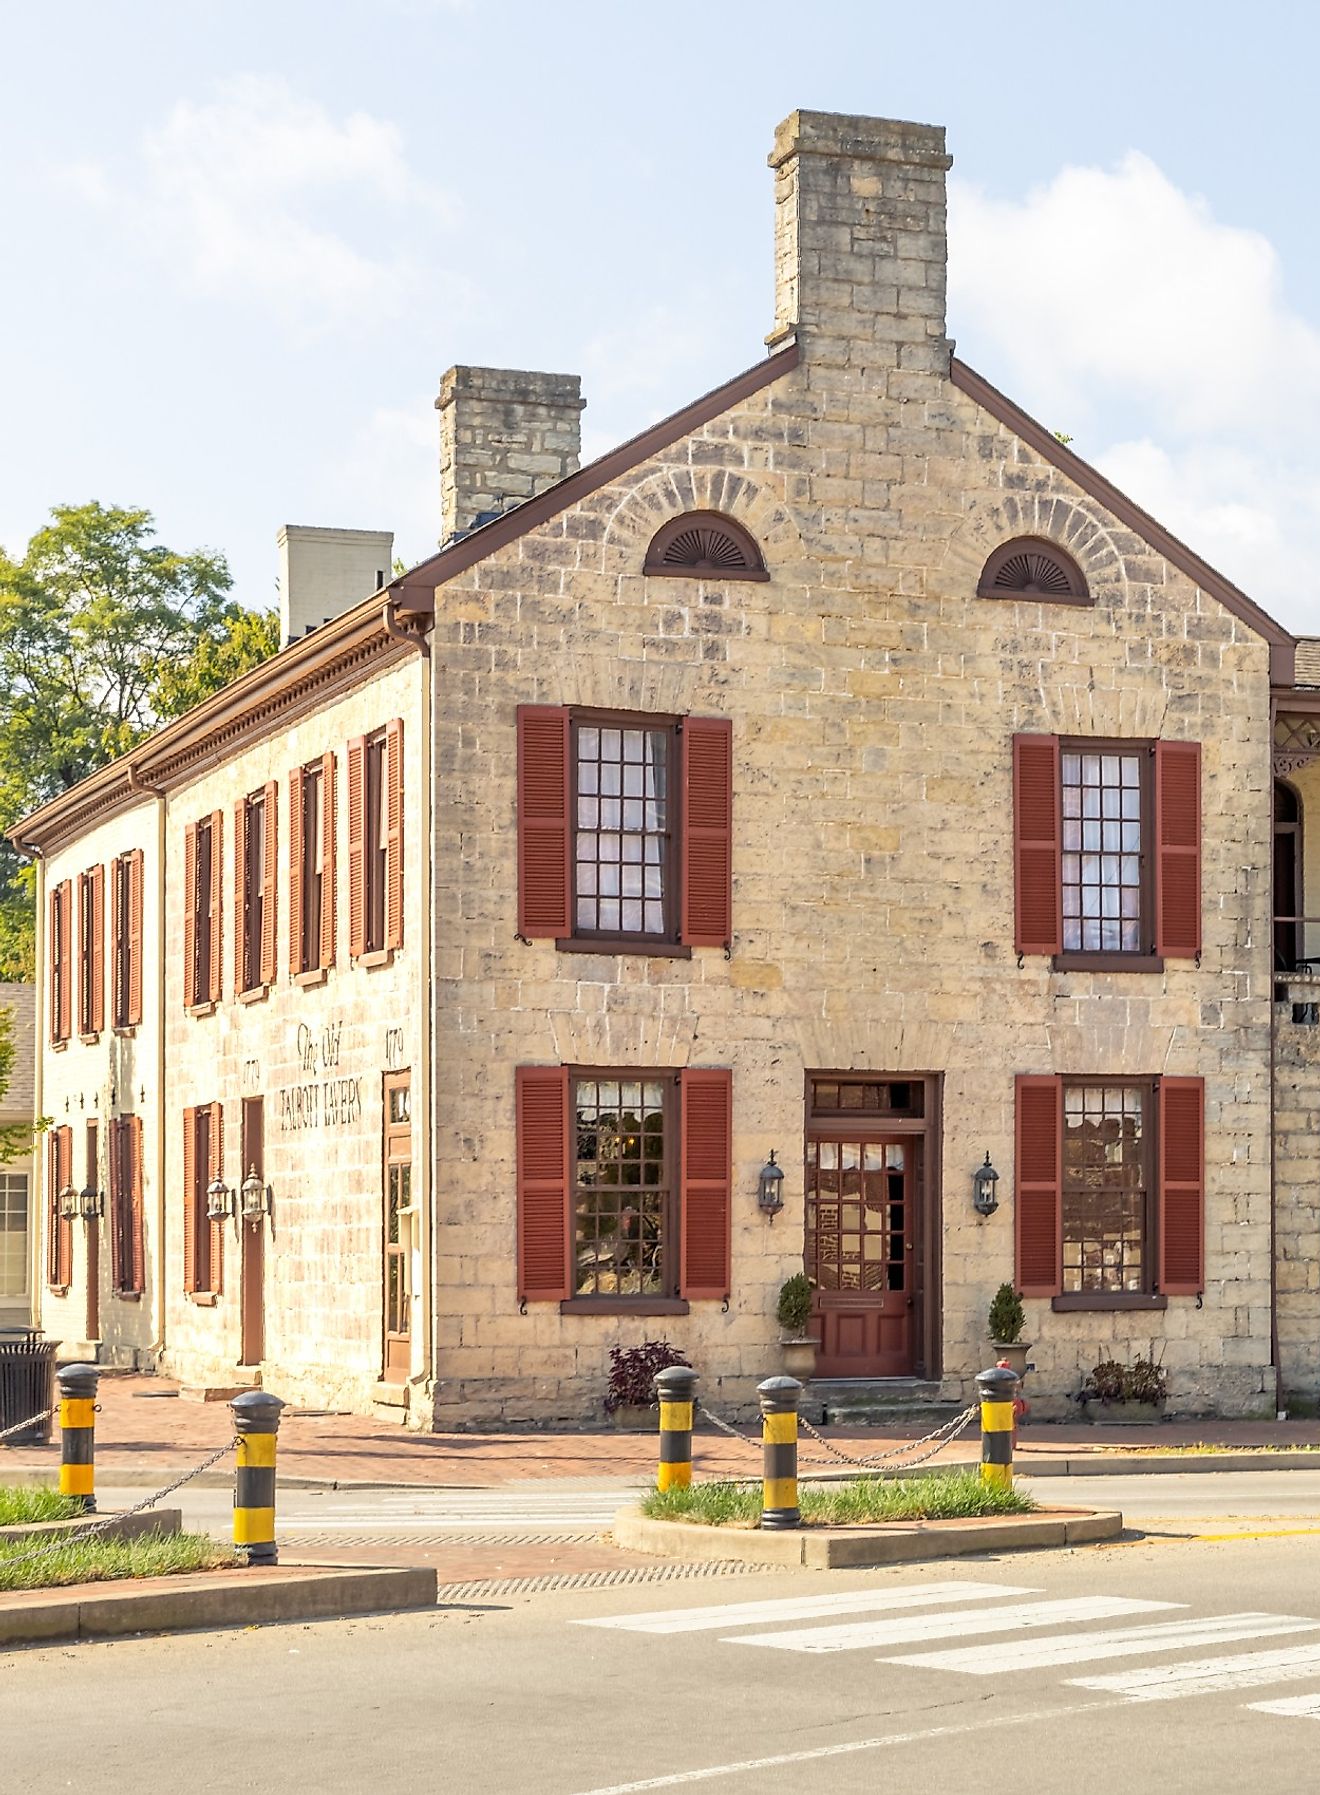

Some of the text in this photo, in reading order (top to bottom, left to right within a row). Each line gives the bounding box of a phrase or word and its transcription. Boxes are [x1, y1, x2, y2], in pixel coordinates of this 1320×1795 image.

[297, 1020, 343, 1077] The Old
[280, 1083, 320, 1131] TALBOTT
